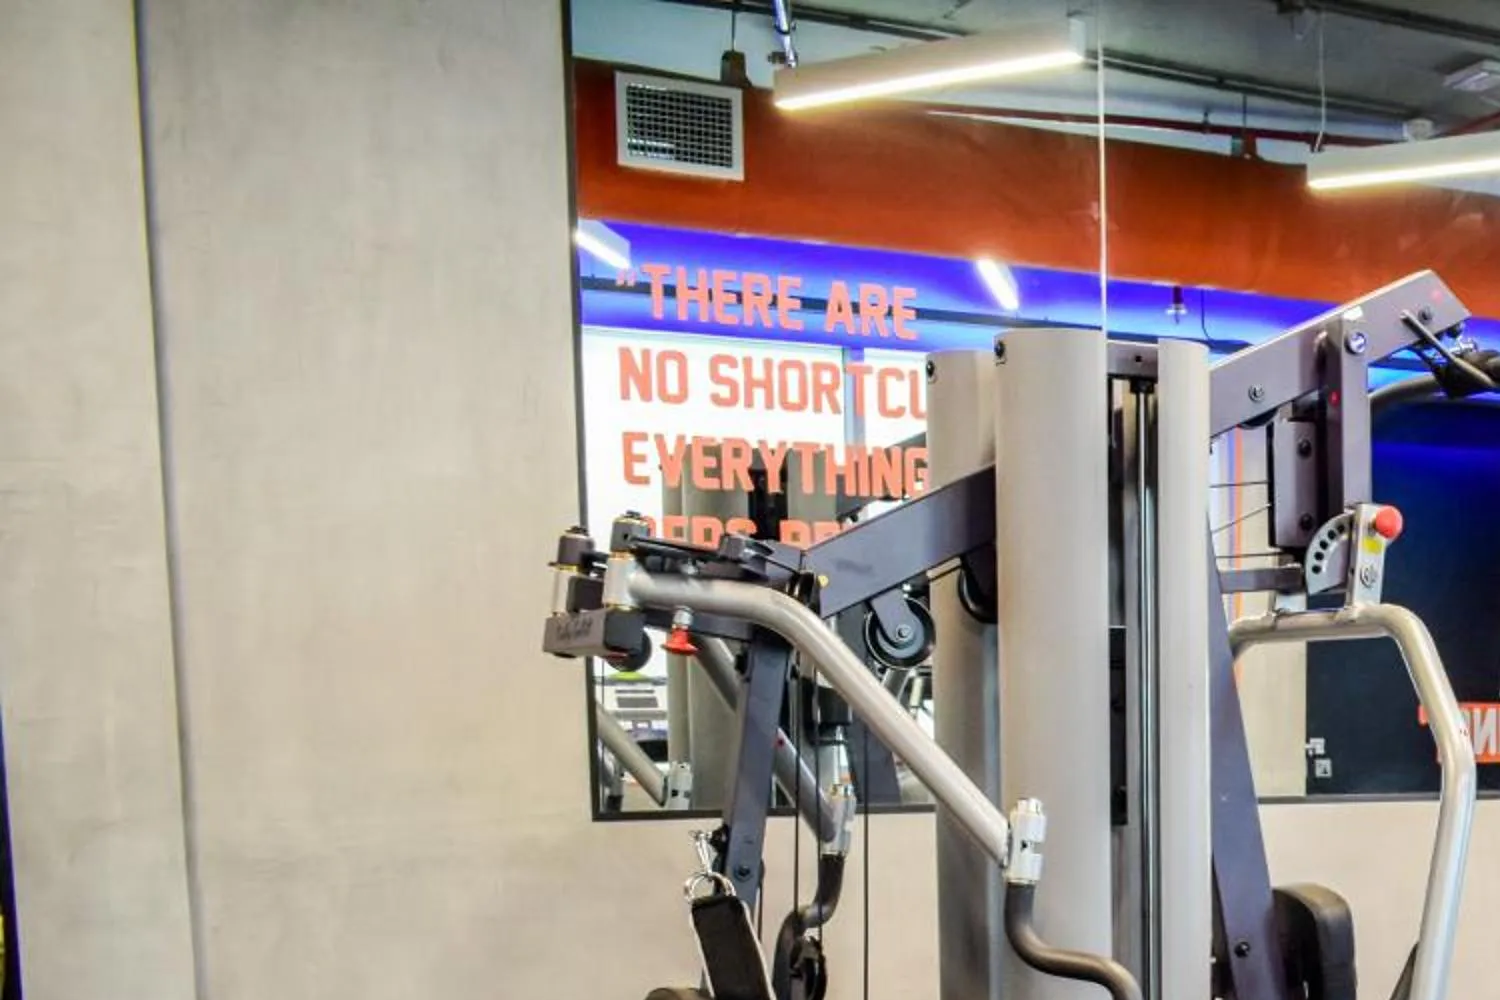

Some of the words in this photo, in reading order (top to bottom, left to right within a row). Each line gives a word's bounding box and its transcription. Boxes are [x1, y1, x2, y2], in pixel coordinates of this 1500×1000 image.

[825, 280, 918, 340] ARE
[618, 346, 689, 404] NO
[622, 432, 929, 499] EVERYTHING
